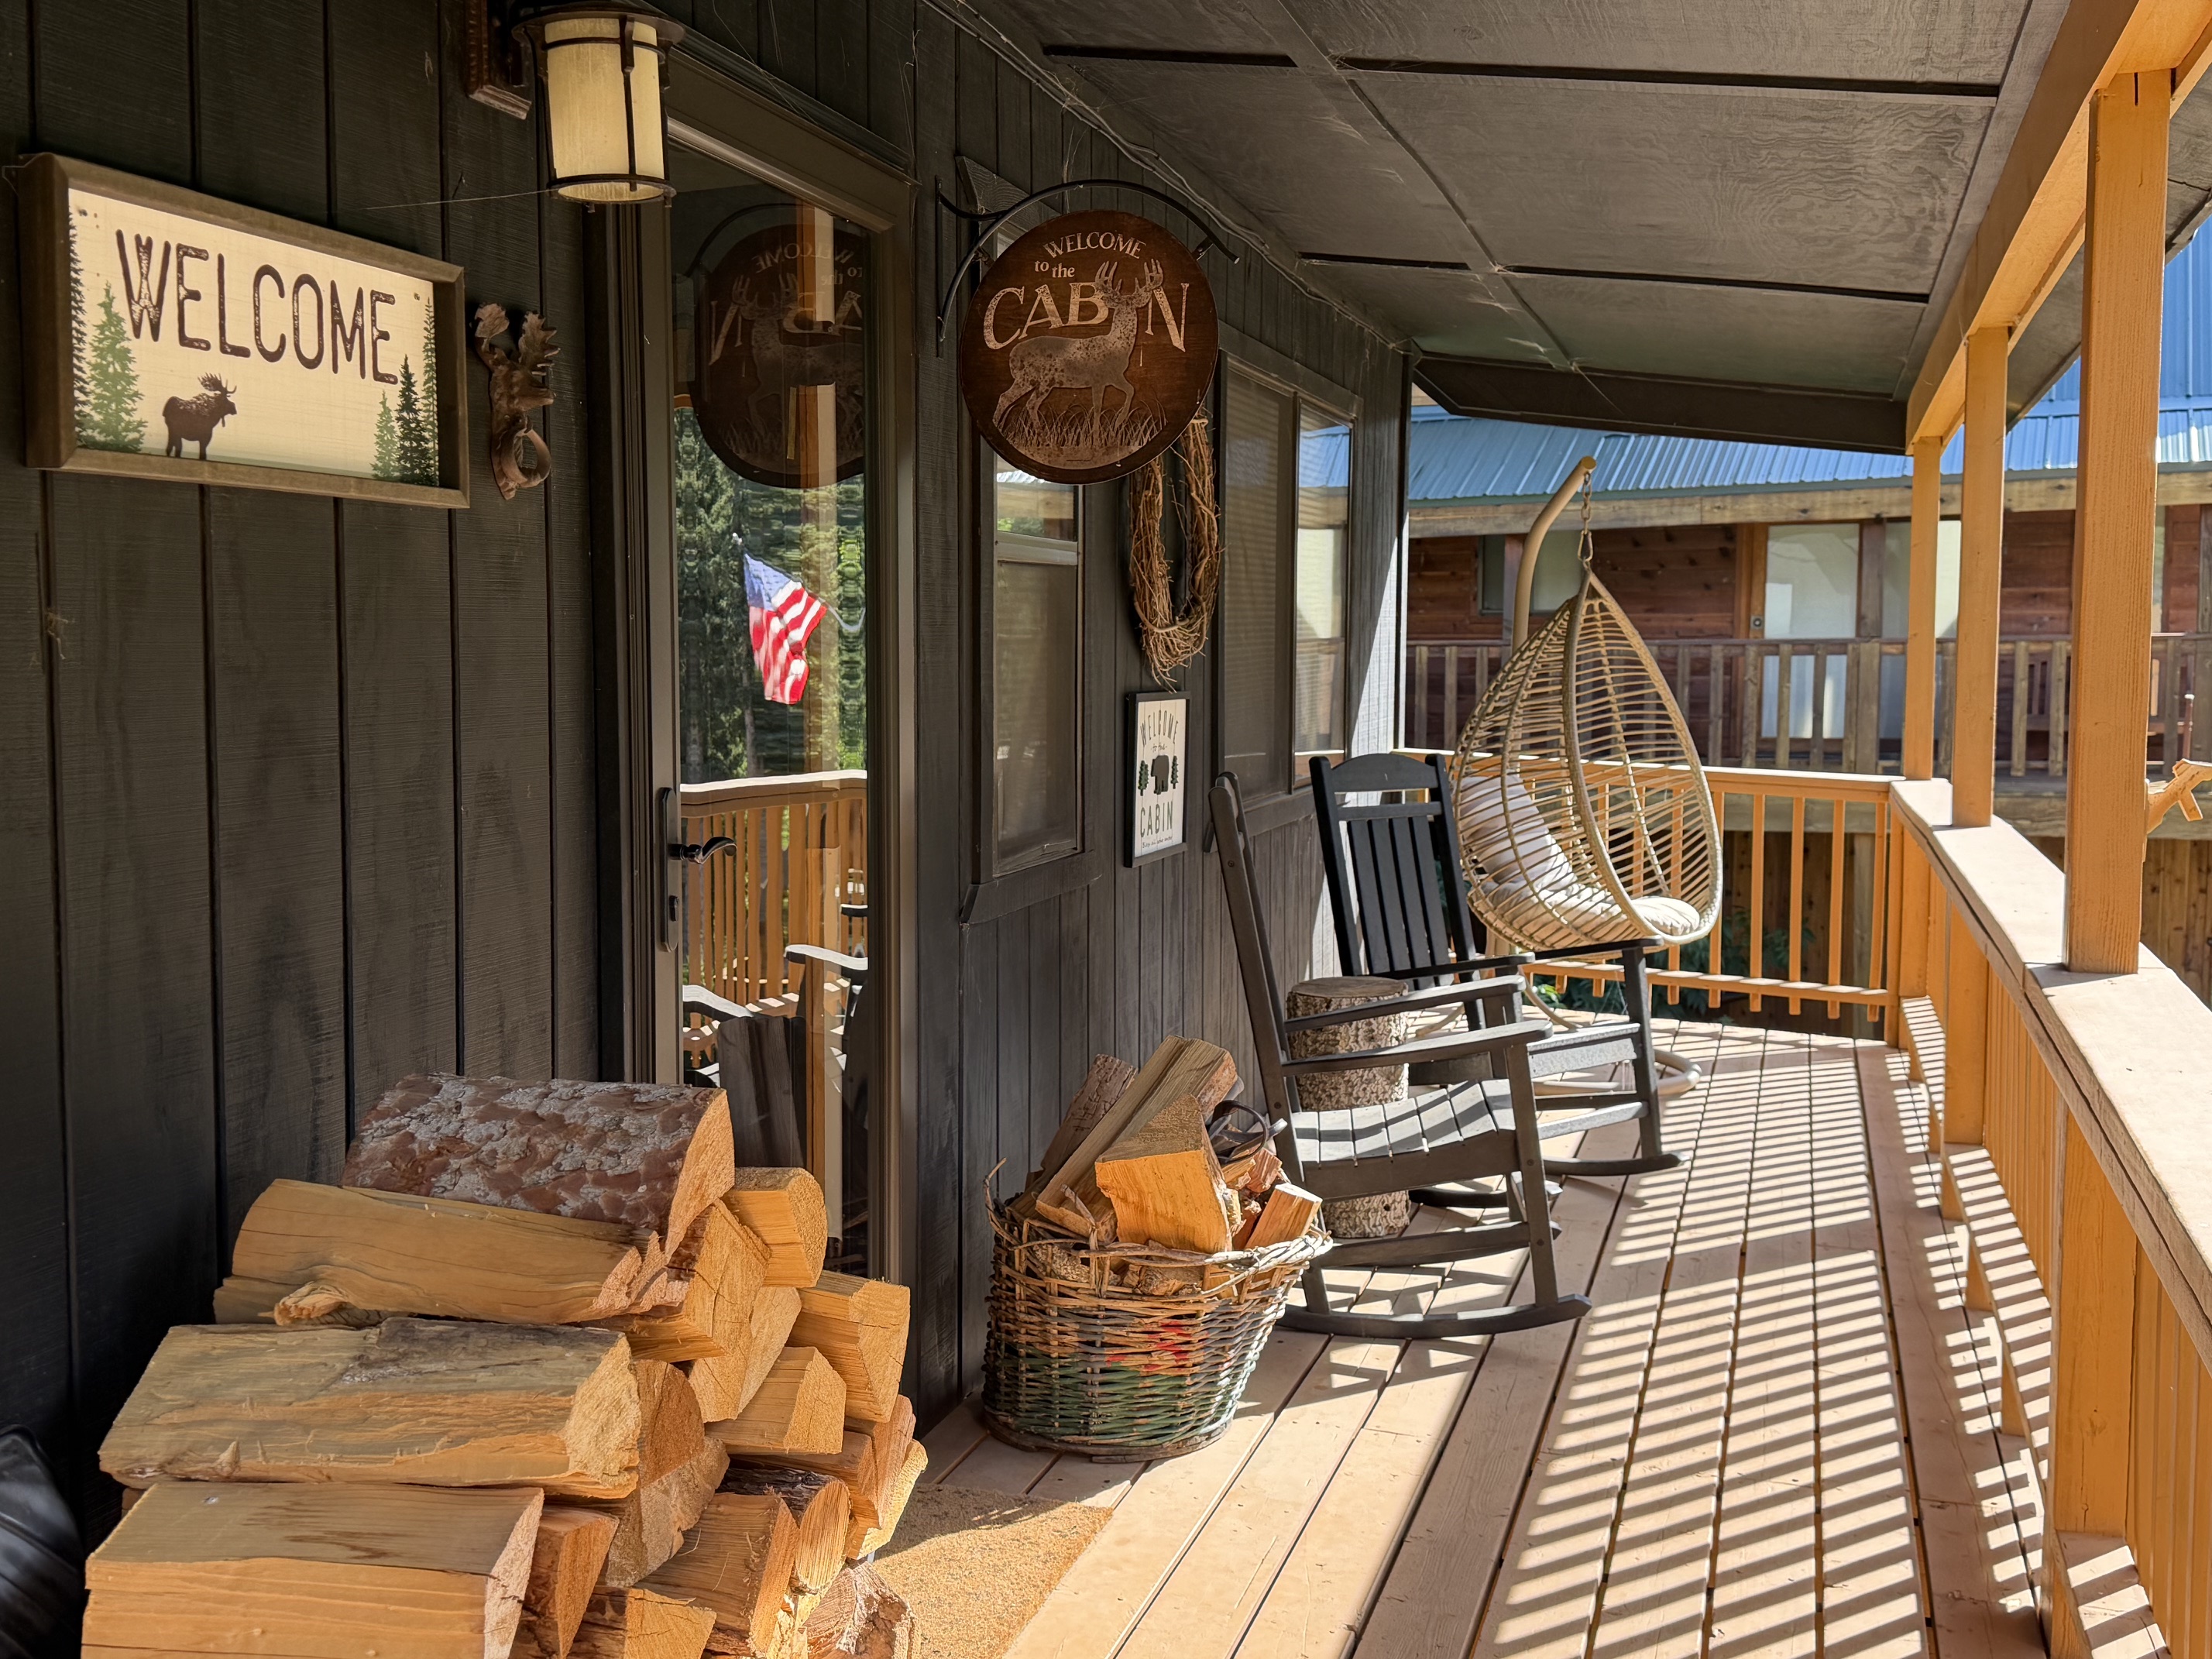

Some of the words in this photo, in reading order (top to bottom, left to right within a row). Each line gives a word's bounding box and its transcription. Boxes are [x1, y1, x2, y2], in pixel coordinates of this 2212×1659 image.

[1042, 232, 1146, 259] WELCOME
[1035, 260, 1049, 273] to
[1051, 263, 1075, 279] the
[116, 229, 398, 385] WELCOME
[983, 282, 1190, 352] CABN
[1140, 709, 1179, 747] WELCOME
[1140, 801, 1173, 838] CABIN
